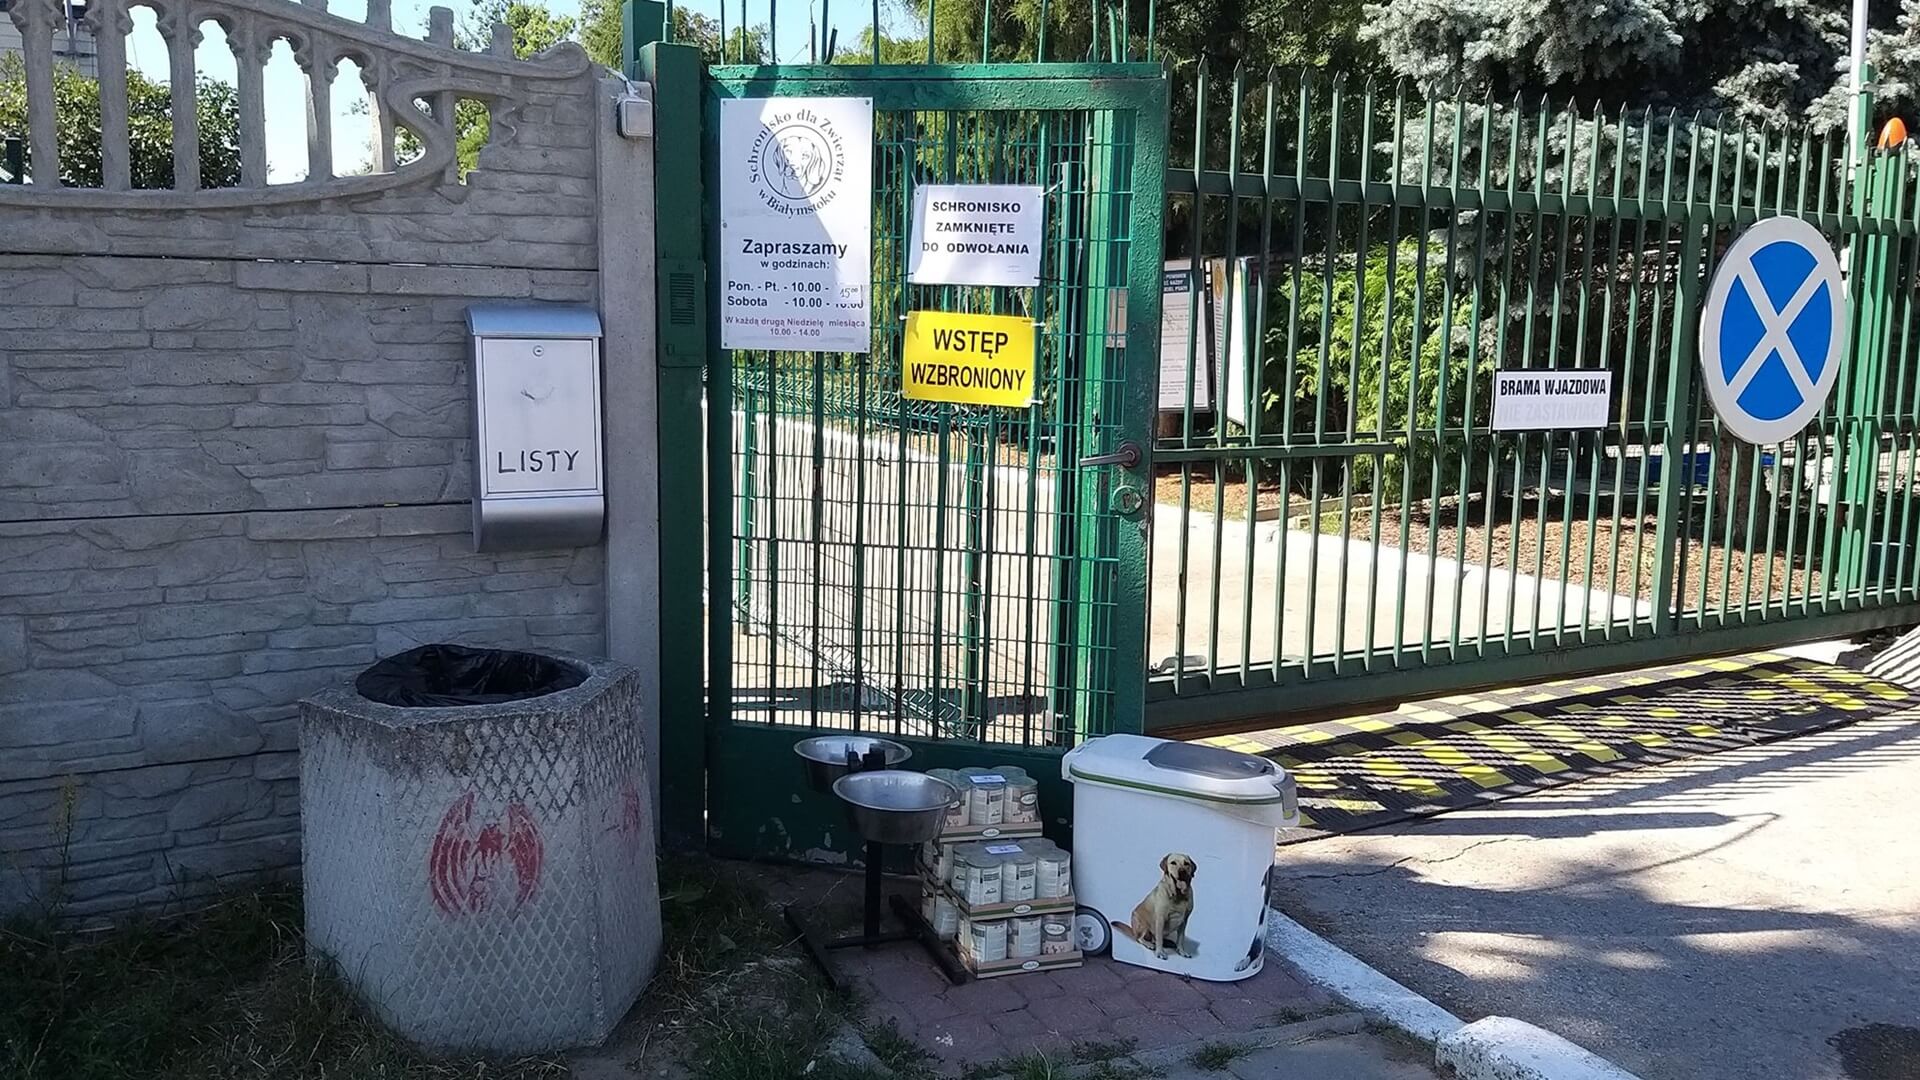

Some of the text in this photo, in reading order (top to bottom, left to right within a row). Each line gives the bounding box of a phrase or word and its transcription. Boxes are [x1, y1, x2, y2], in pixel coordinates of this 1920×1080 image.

[747, 113, 791, 184] Schronisko
[796, 108, 817, 124] dla
[932, 201, 1021, 213] SCHRONISKO
[936, 222, 1015, 236] ZAMKNIĘTE
[742, 239, 847, 259] Zapraszamy
[922, 242, 1030, 254] DO ODWOŁANIA
[760, 260, 830, 270] w godzinach:
[728, 281, 754, 291] Pon.
[764, 281, 780, 292] Pt.
[791, 282, 821, 292] 10.00
[727, 296, 768, 307] Sobota
[792, 297, 822, 308] 10.00
[725, 316, 865, 329] W każdą drugą Niedzielę miesiąca
[770, 328, 791, 336] 10.00
[799, 329, 820, 337] 14.00
[934, 328, 1008, 359] WSTĘP
[911, 362, 1026, 391] WZBRONIONY
[1500, 379, 1606, 396] BRAMA WJAZDOWA
[498, 450, 579, 473] LISTY
